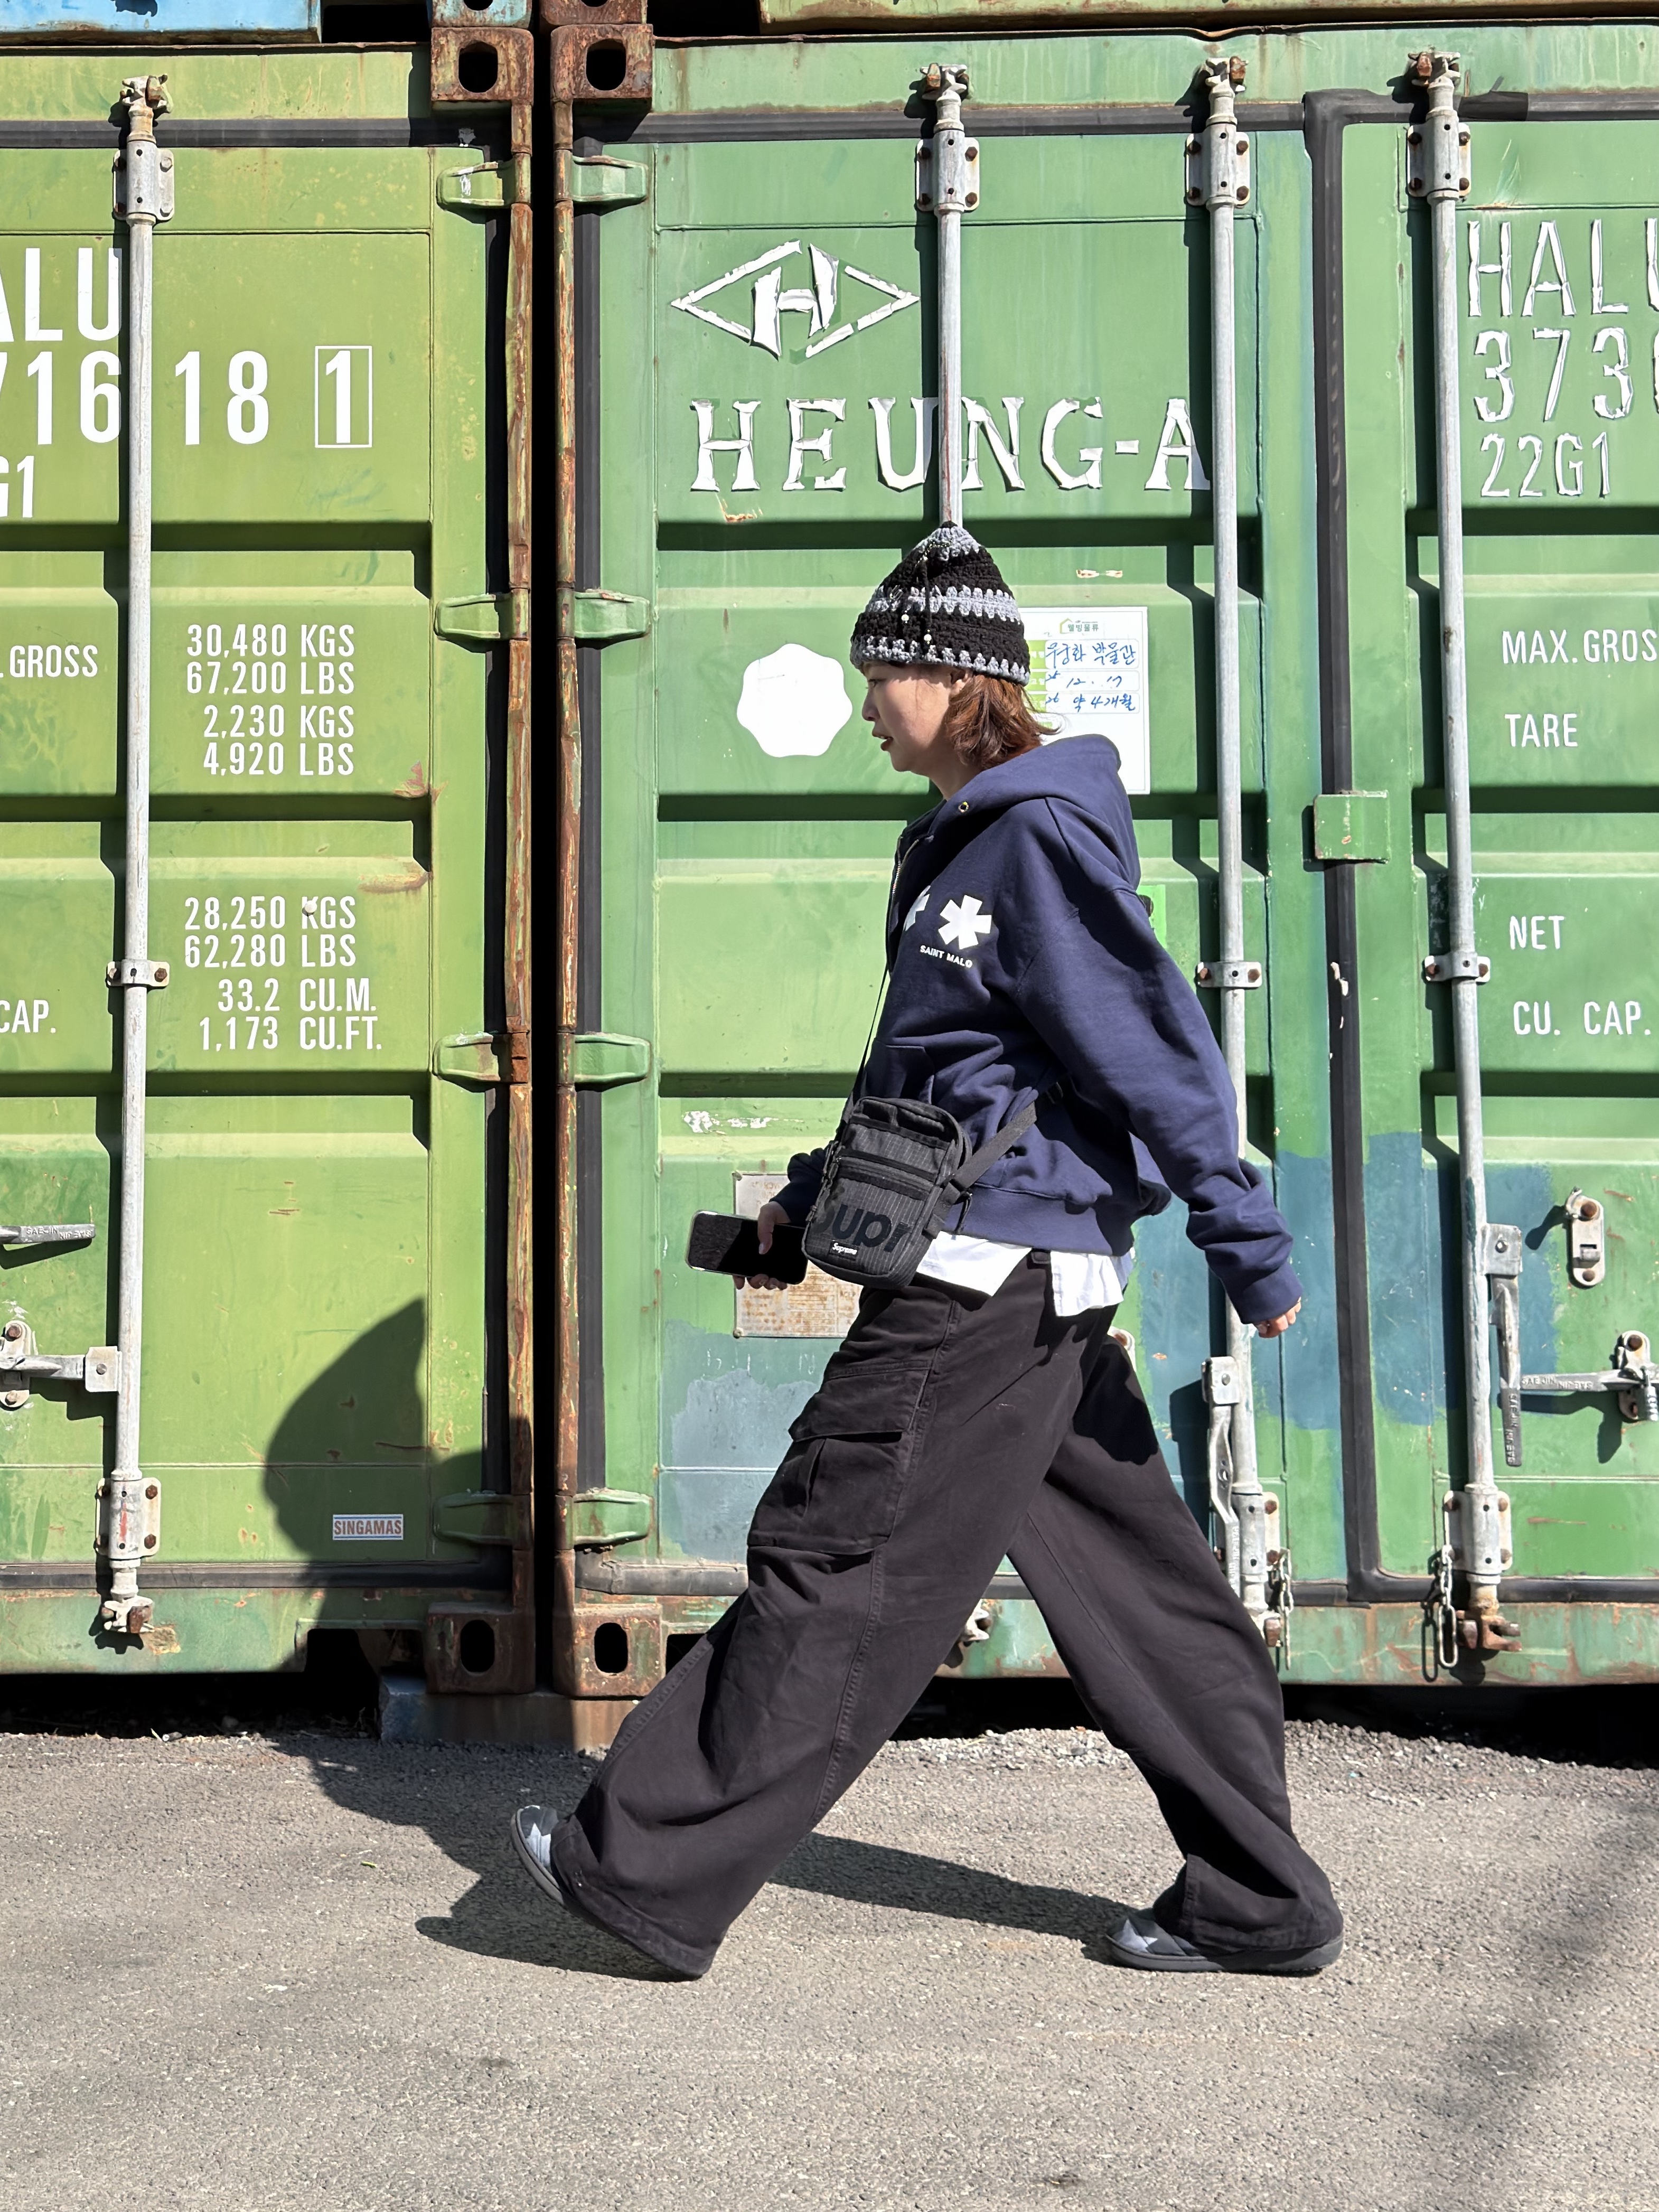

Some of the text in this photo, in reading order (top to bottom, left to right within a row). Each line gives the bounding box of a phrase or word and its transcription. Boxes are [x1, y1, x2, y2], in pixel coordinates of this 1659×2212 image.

[1474, 327, 1659, 422] 373
[0, 351, 121, 445] 16
[690, 396, 1210, 491] HEUNG-A
[1480, 432, 1610, 498] 22G1
[187, 624, 354, 658] 30,480 KGS
[1092, 642, 1136, 666] 박물관
[187, 661, 354, 695] 67,200 LBS
[204, 705, 354, 739] 2,230 KGS
[1504, 713, 1578, 748] TARE
[203, 742, 354, 776] 4,920 LBS
[185, 896, 356, 931] 28,250 KGS
[1509, 915, 1565, 950] NET
[185, 934, 356, 970] 62,280 LBS
[920, 945, 973, 968] SAINT MALO
[218, 978, 280, 1013] 33.2
[0, 999, 56, 1033] CAP.
[1513, 1000, 1651, 1036] CU. CAP.
[200, 1016, 278, 1052] 1,173
[832, 1242, 858, 1255] Supreme
[334, 1520, 402, 1535] SINGAMAS
